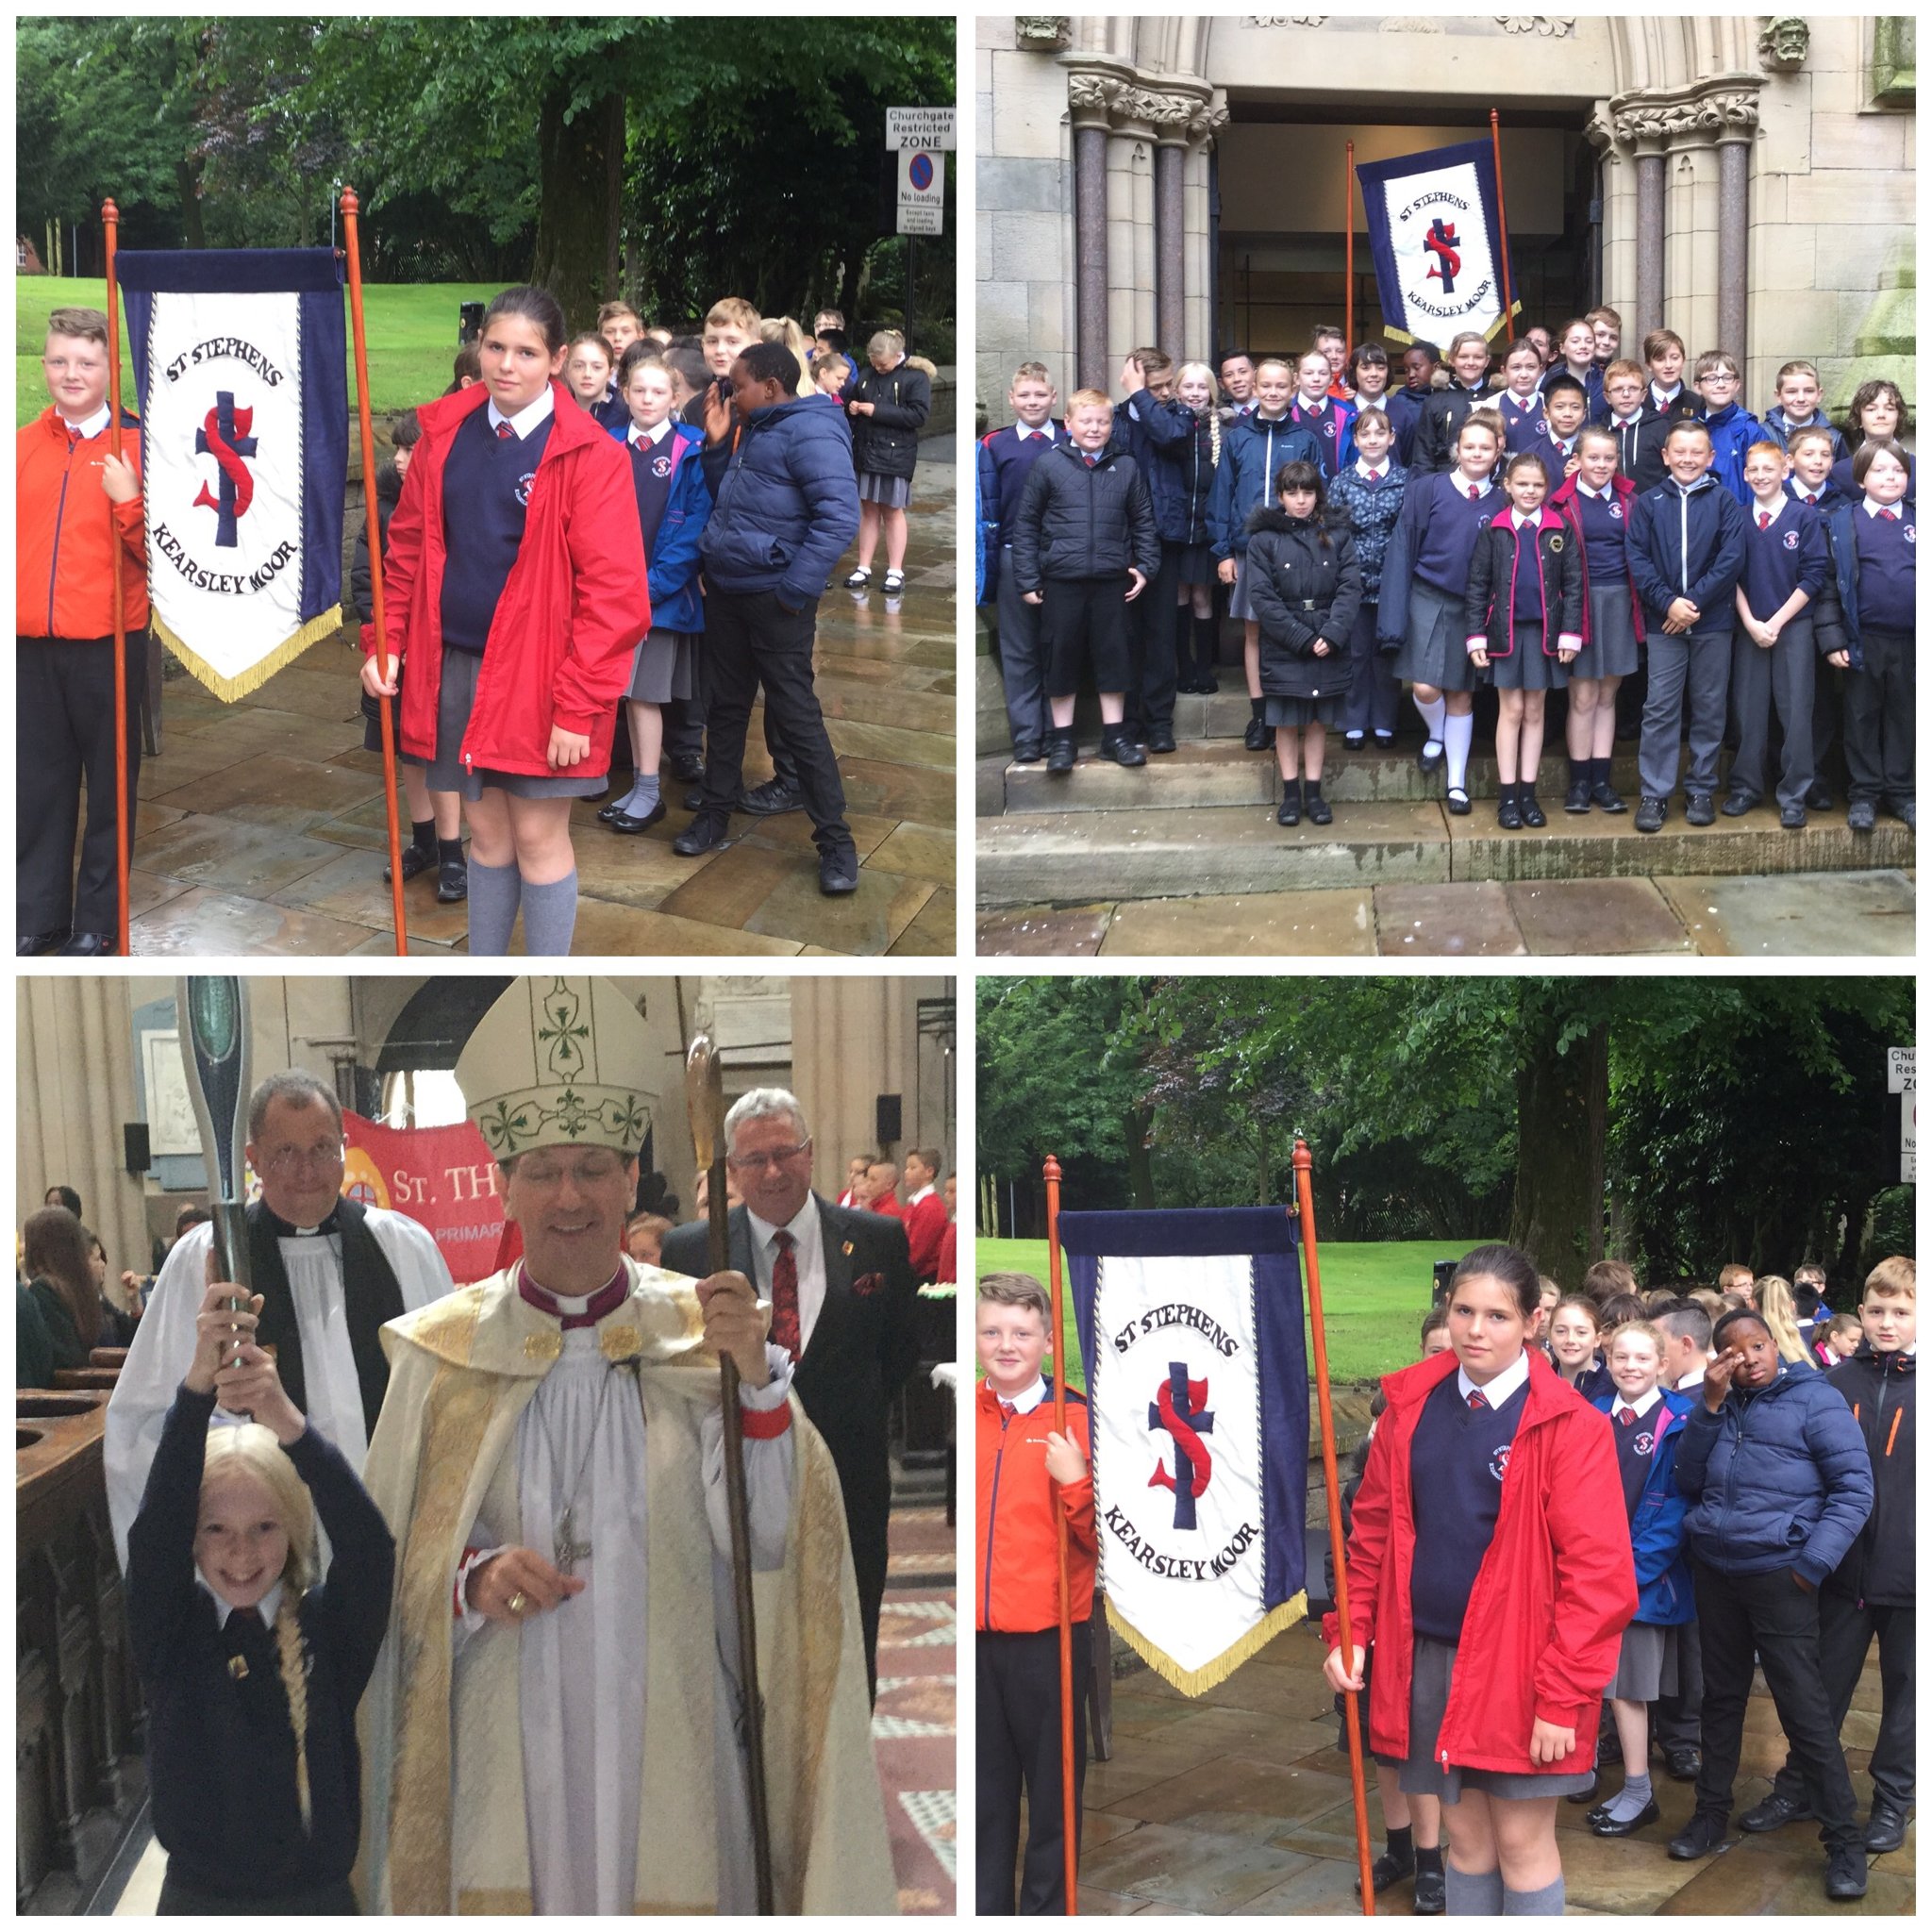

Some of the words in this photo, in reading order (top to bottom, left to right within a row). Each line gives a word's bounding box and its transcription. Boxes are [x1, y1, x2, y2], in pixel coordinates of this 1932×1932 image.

[890, 110, 954, 121] Churchgate
[893, 123, 950, 133] Restricted
[900, 136, 941, 148] ZONE
[901, 192, 911, 201] No
[914, 192, 941, 205] loading
[1400, 206, 1412, 222] ST
[1413, 192, 1470, 210] STEPHENS
[1407, 291, 1462, 317] KEARSLEY
[1465, 280, 1491, 310] MOOR
[166, 352, 187, 383] ST
[192, 337, 284, 387] STEPHENS
[152, 522, 246, 594] KEARSLEY
[249, 541, 298, 591] MOOR
[1905, 1138, 1916, 1148] No
[444, 1162, 500, 1202] TH
[435, 1222, 504, 1243] PRIMAR
[1114, 1320, 1137, 1354] ST
[1141, 1303, 1240, 1357] STEPHENS
[1105, 1504, 1207, 1580] KEARSLEY
[1209, 1522, 1259, 1577] MOOR
